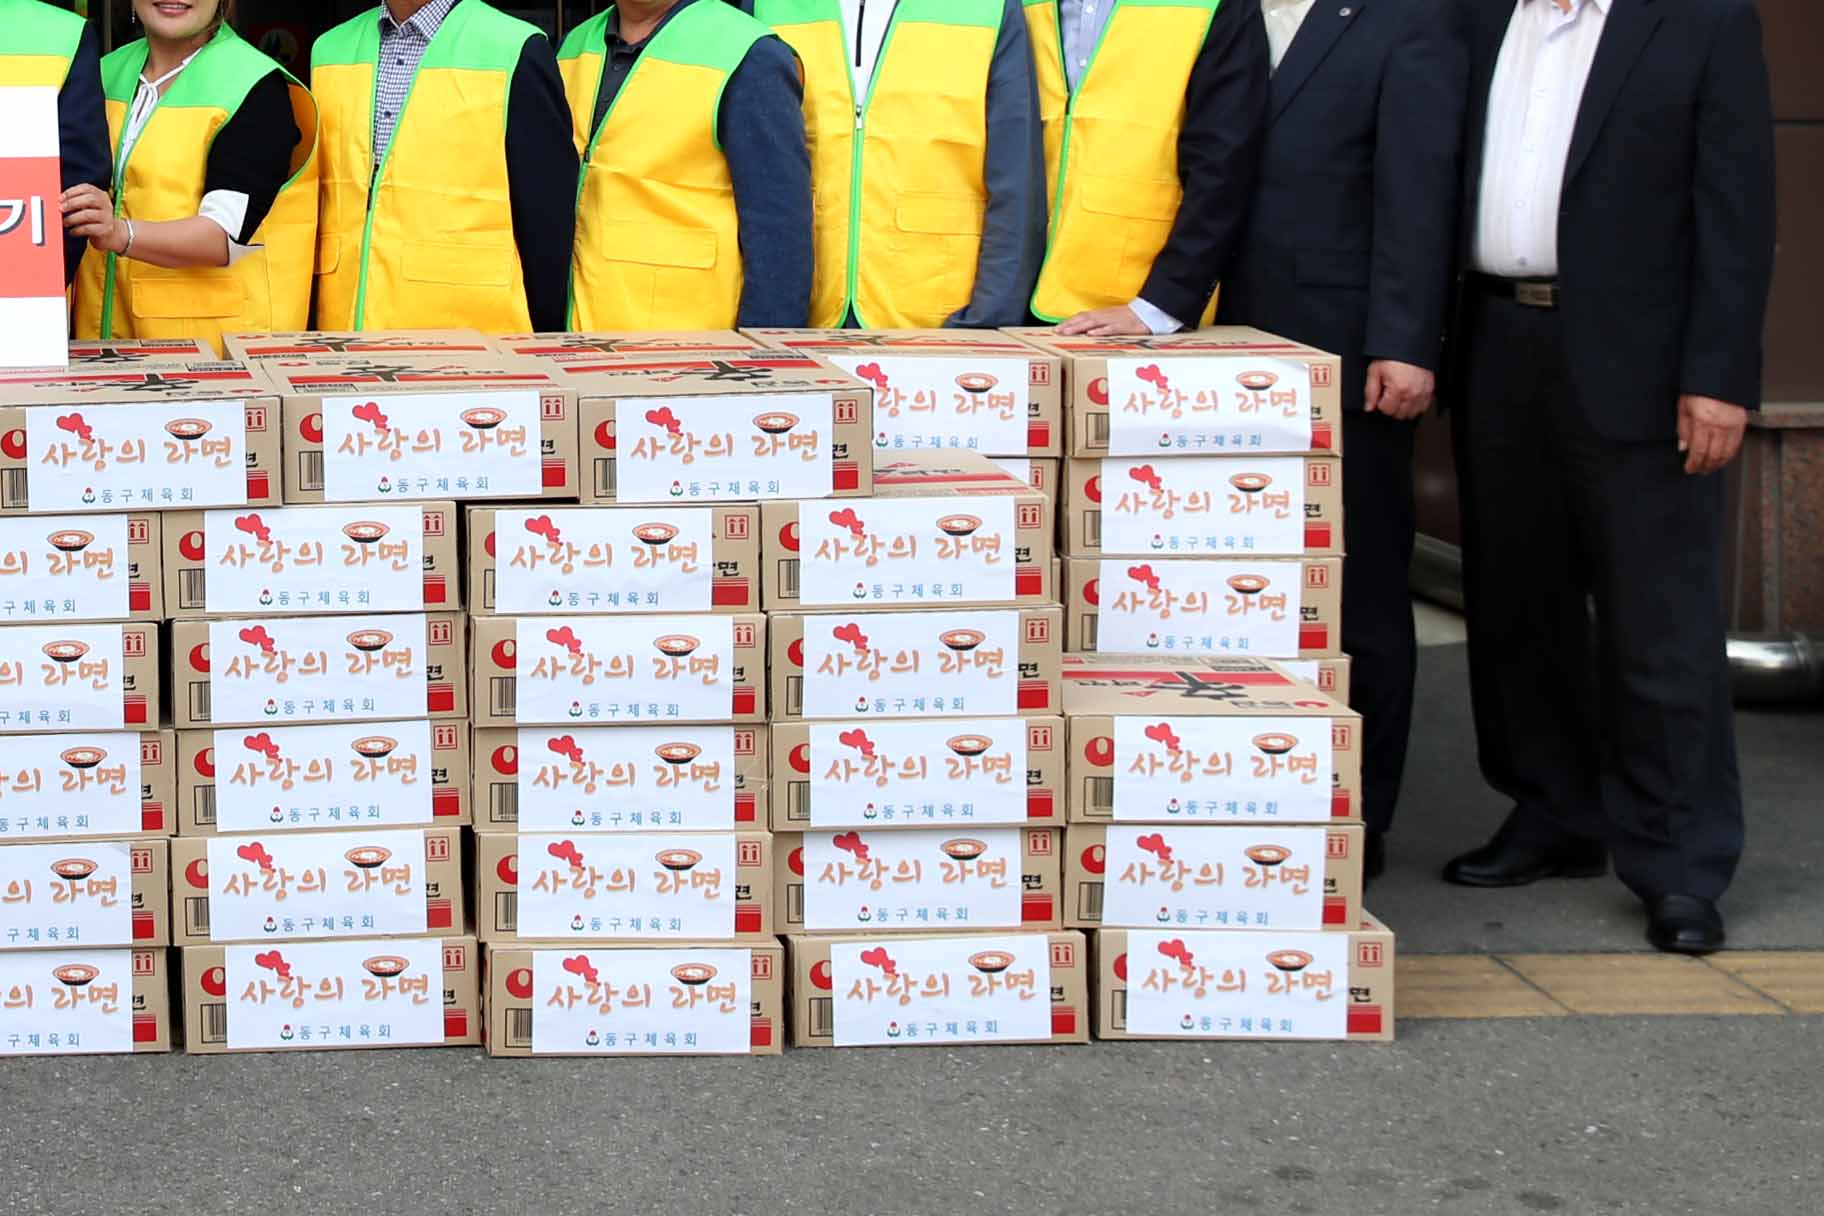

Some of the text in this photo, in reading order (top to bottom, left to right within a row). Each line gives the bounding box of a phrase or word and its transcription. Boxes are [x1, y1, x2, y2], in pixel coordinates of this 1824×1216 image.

[875, 386, 1015, 421] 랑의 라면
[1119, 384, 1297, 418] 사랑의 라면
[42, 433, 232, 472] 사랑의 라면
[339, 422, 526, 461] 사랑의 라면
[631, 429, 734, 465] 사랑의
[751, 427, 818, 462] 라면
[1111, 485, 1290, 520] 사랑의 라면
[47, 545, 114, 580] 라면
[510, 539, 613, 575] 사랑의
[631, 538, 698, 574] 라면
[814, 530, 1001, 567] 사랑의 라면
[1108, 585, 1287, 621] 사랑의 라면
[41, 656, 109, 689] 라면
[226, 645, 413, 683] 사랑의 라면
[529, 650, 720, 686] 사랑의 라면
[59, 762, 127, 796] 라면
[231, 751, 417, 791] 사랑의 라면
[825, 750, 1012, 786] 사랑의 라면
[1129, 746, 1318, 785] 사랑의 라면
[222, 862, 411, 902] 사랑의 라면
[530, 863, 721, 900] 사랑의 라면
[1118, 856, 1311, 896] 사랑의 라면
[51, 980, 119, 1014] 라면
[548, 979, 737, 1015] 사랑의 라면
[846, 966, 1035, 1006] 사랑의 라면
[1143, 963, 1333, 1001] 사랑의 라면
